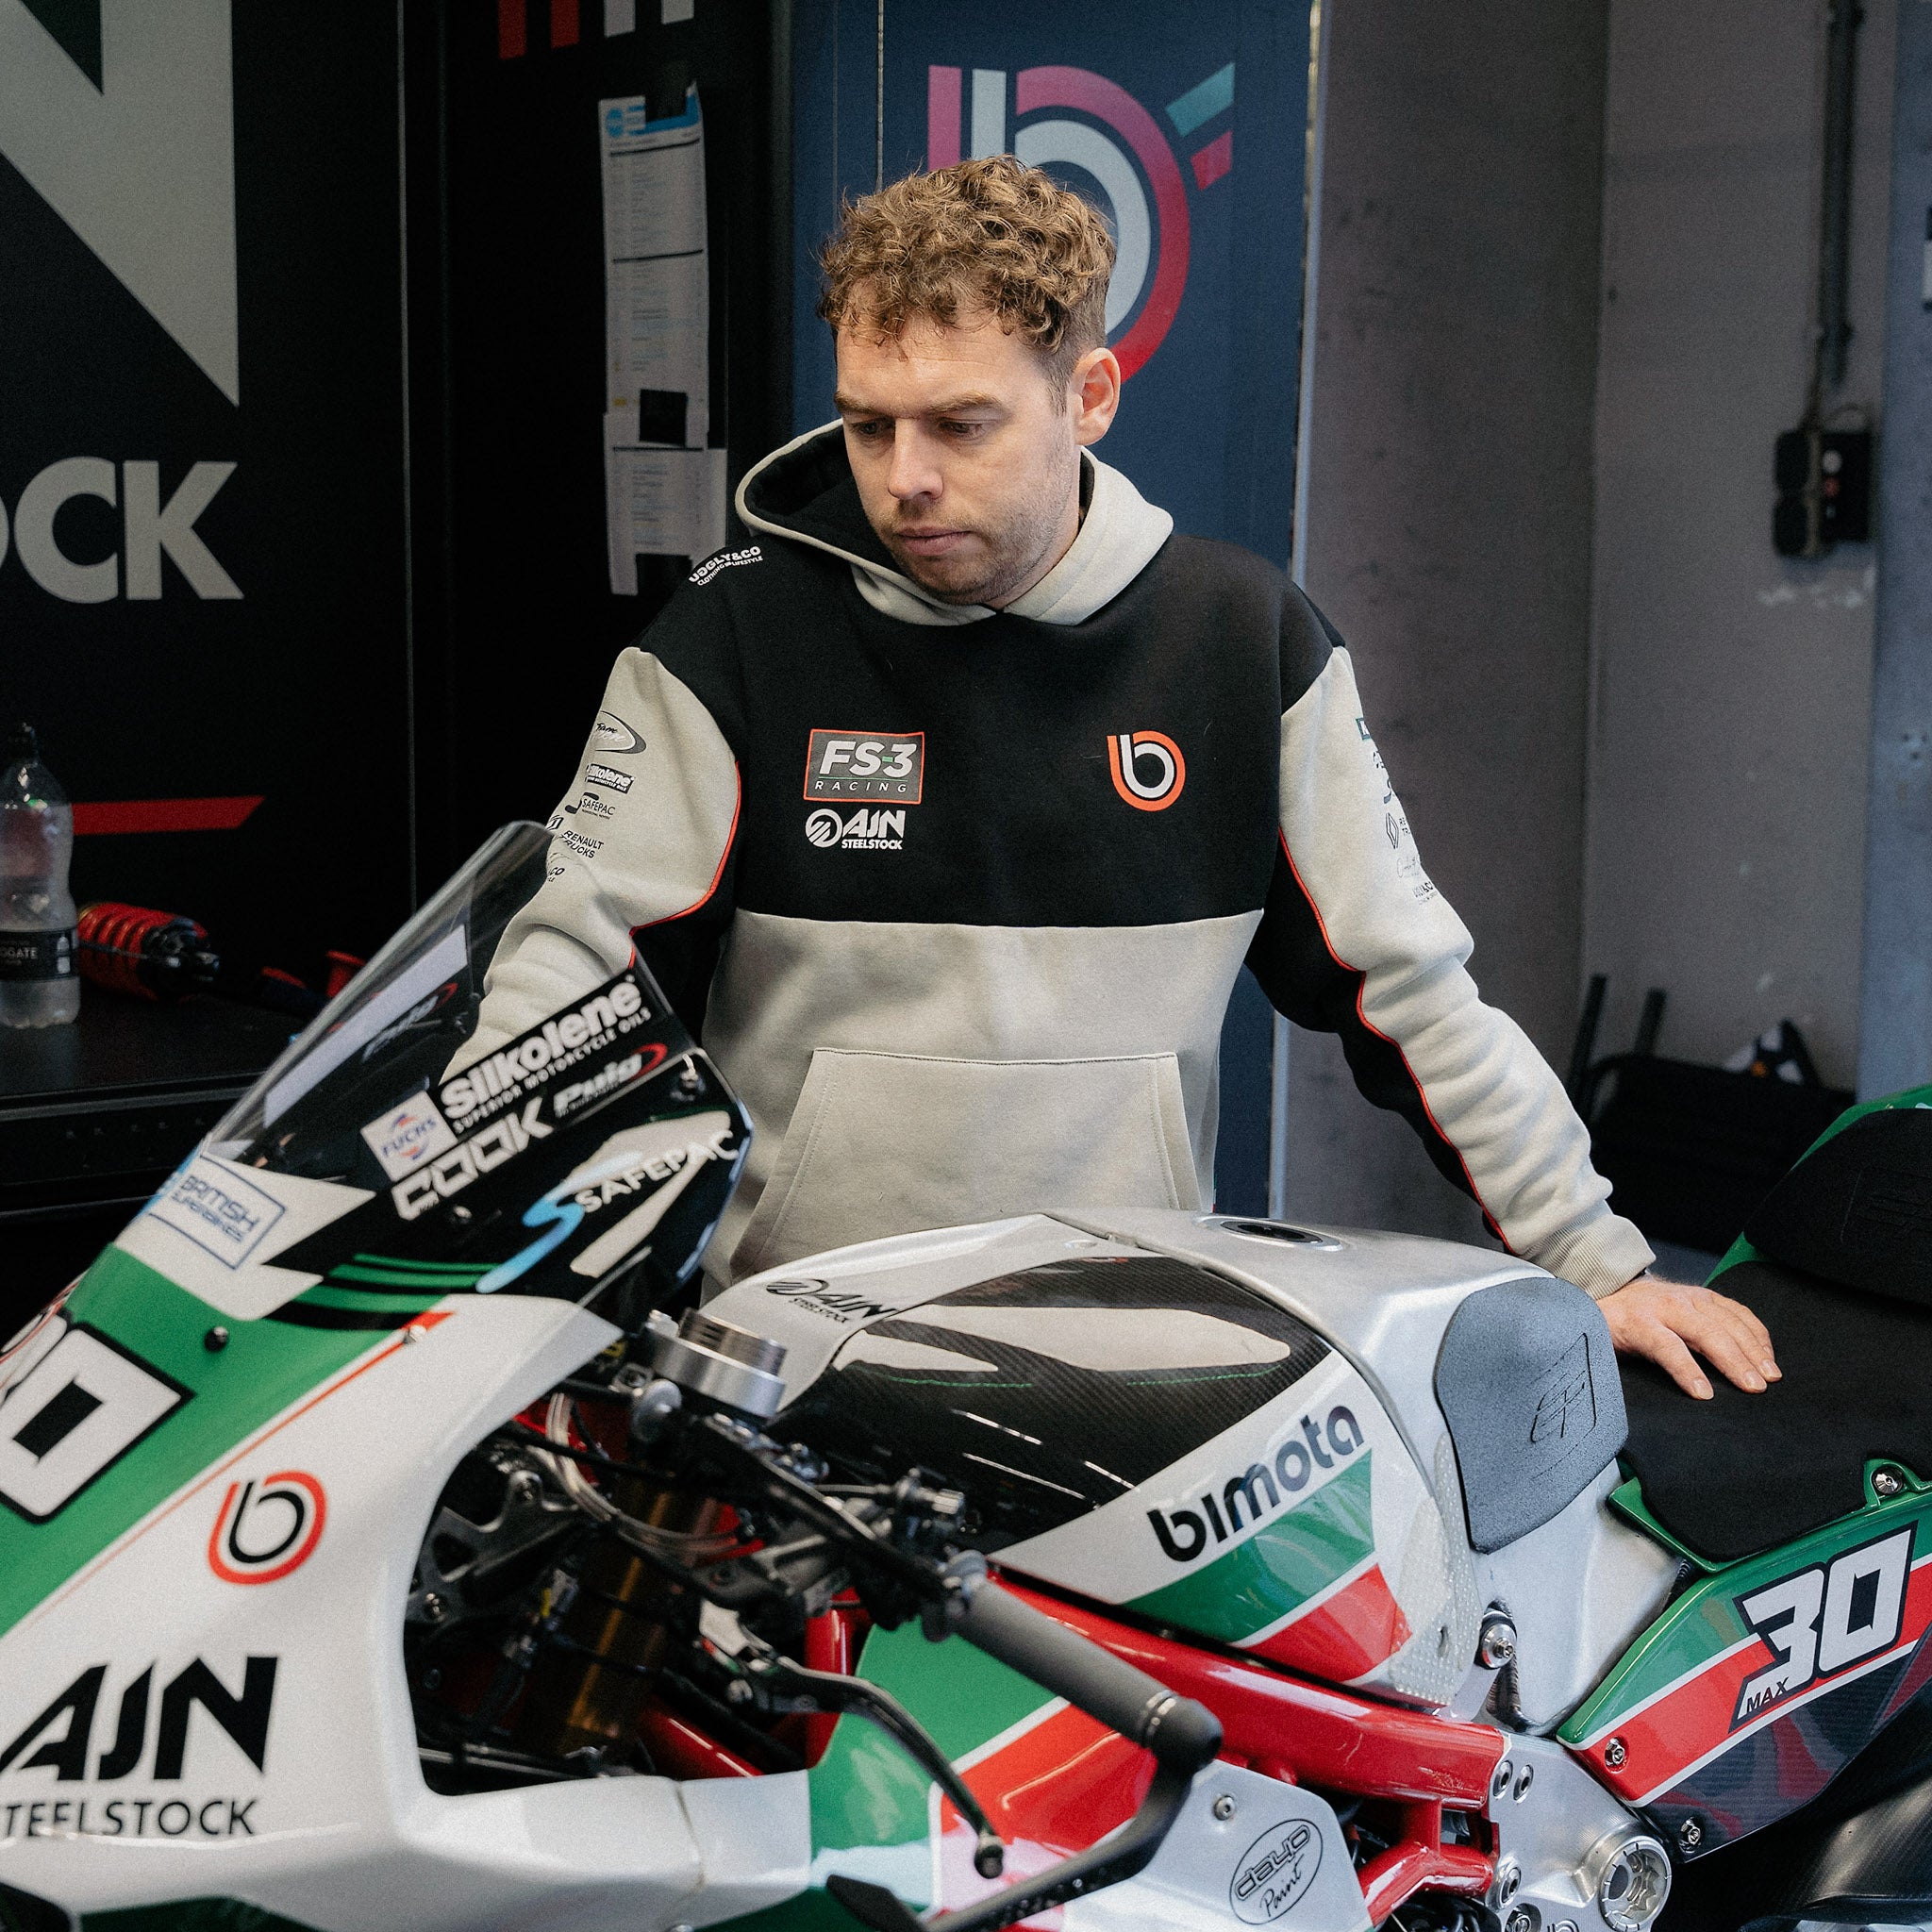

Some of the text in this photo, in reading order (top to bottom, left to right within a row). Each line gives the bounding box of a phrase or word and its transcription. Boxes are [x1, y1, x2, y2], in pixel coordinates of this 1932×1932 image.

[0, 456, 244, 604] CK
[819, 740, 918, 778] FS-3
[814, 780, 908, 792] RACING
[582, 798, 616, 816] SAFEPAC
[841, 808, 906, 839] AJN
[563, 830, 605, 850] RENAULT
[841, 839, 903, 850] STEELSTOCK
[452, 1084, 523, 1134] SUPERIOR
[524, 1028, 617, 1089] MOTORCYCLE
[618, 1006, 653, 1034] OILS
[381, 1118, 437, 1158] FUCHS
[575, 1129, 740, 1213] SAFEPAC
[1146, 1406, 1365, 1562] bimota
[1734, 1524, 1917, 1723] 30
[1745, 1676, 1790, 1712] MAX
